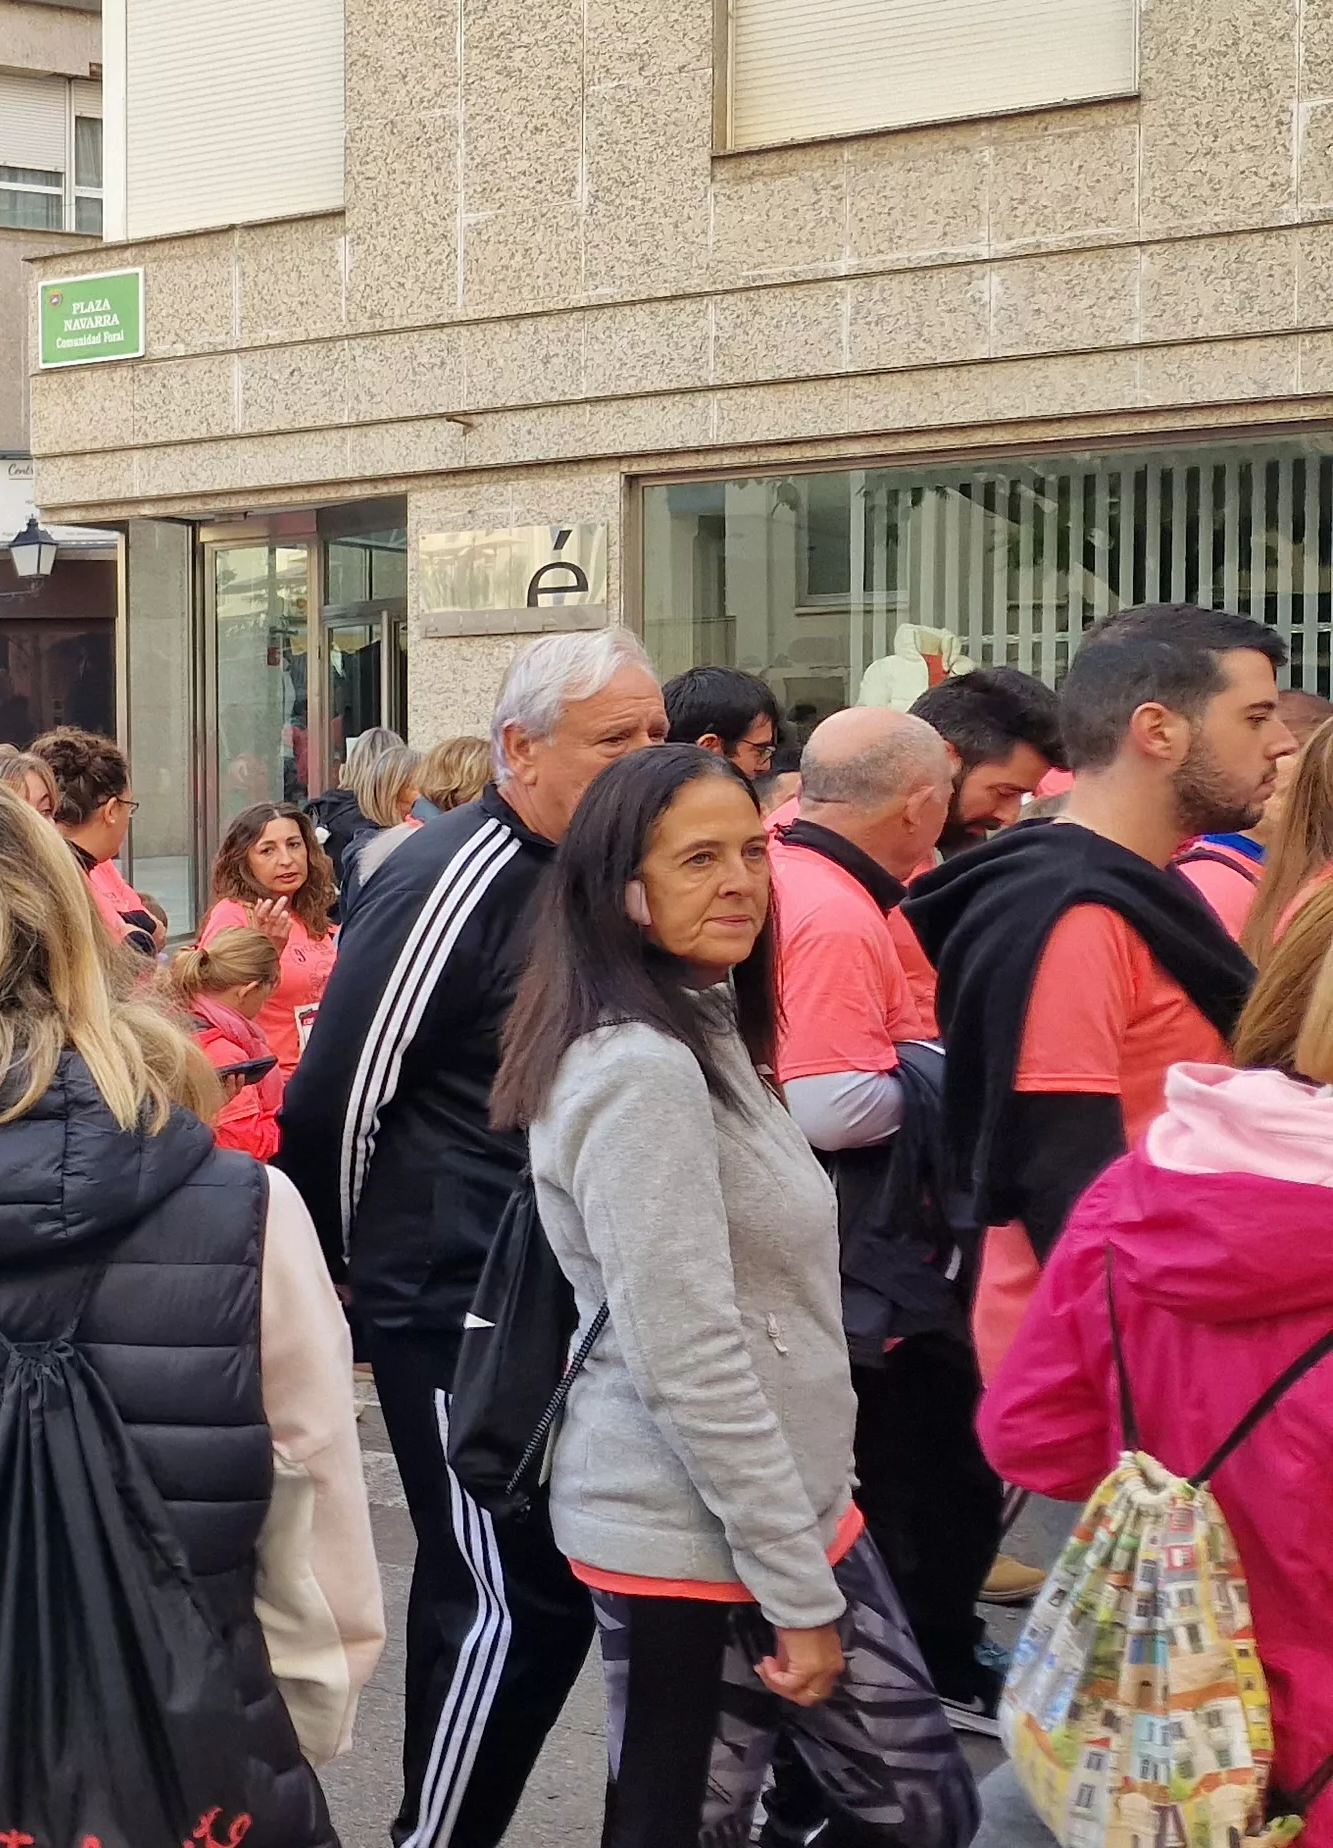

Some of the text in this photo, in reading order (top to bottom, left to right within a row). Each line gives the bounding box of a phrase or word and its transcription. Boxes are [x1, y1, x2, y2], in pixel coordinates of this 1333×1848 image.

[72, 298, 111, 314] PLAZA
[63, 313, 120, 332] NAVARRA
[56, 329, 124, 349] Comunidad Foral
